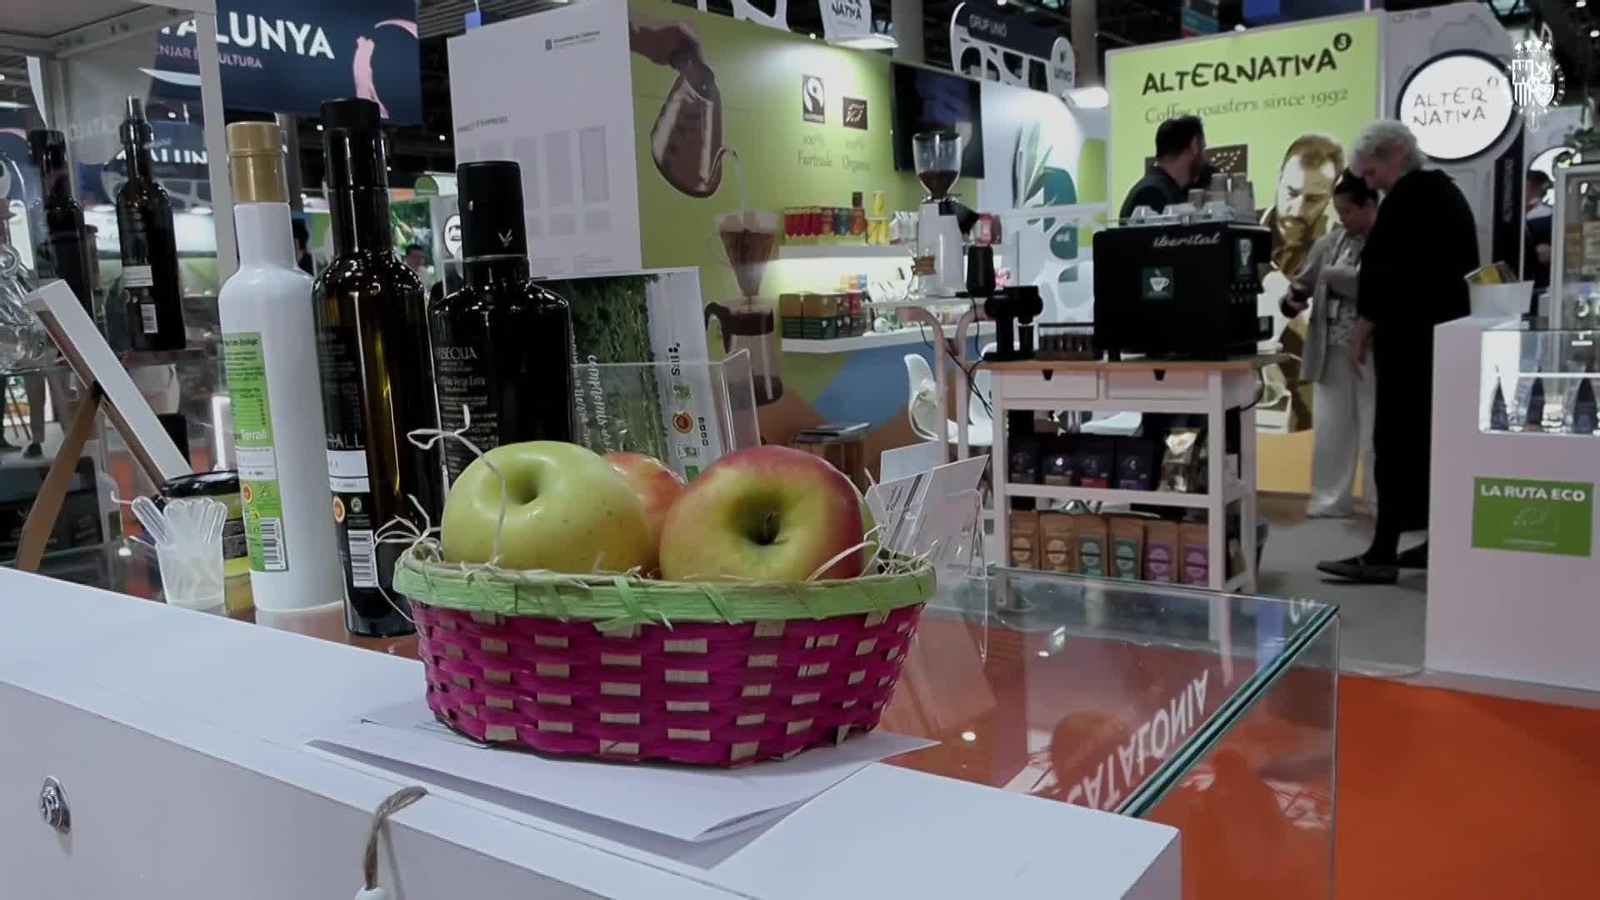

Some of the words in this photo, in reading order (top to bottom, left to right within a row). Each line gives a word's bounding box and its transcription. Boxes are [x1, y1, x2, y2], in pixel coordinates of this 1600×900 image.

[1142, 47, 1337, 96] ALTERNATIVA
[1196, 97, 1259, 117] roasters
[1263, 92, 1305, 110] since
[1310, 88, 1349, 106] 1992
[1413, 86, 1488, 109] ALTER
[1412, 105, 1486, 127] NATIVA
[1152, 232, 1221, 248] iberital
[1480, 484, 1501, 498] LA
[1504, 485, 1549, 500] RUTA
[1551, 487, 1587, 502] ECO
